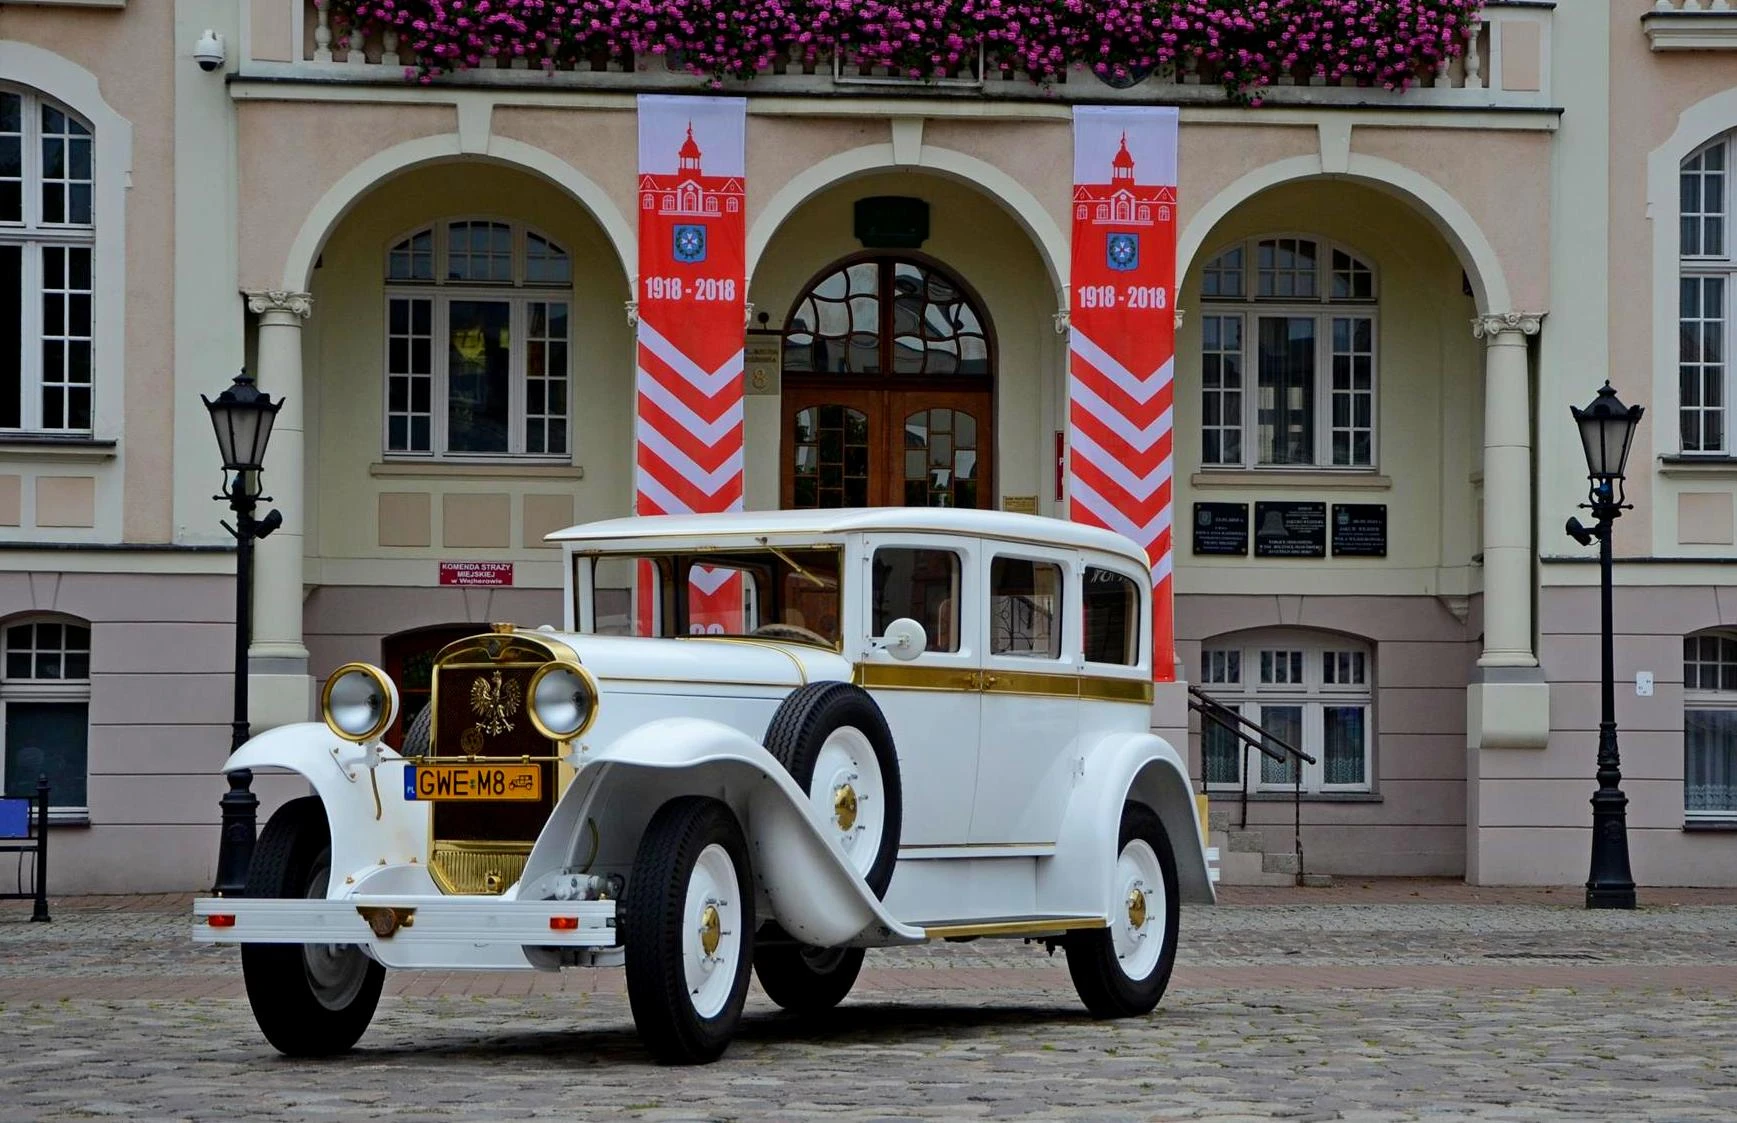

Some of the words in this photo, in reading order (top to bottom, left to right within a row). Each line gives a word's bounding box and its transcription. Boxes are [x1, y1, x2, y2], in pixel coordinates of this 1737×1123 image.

[645, 277, 682, 300] 1918
[695, 279, 735, 301] 2018
[1078, 285, 1115, 308] 1918
[1128, 286, 1166, 309] 2018
[420, 770, 469, 796] GWE
[477, 770, 506, 796] M8
